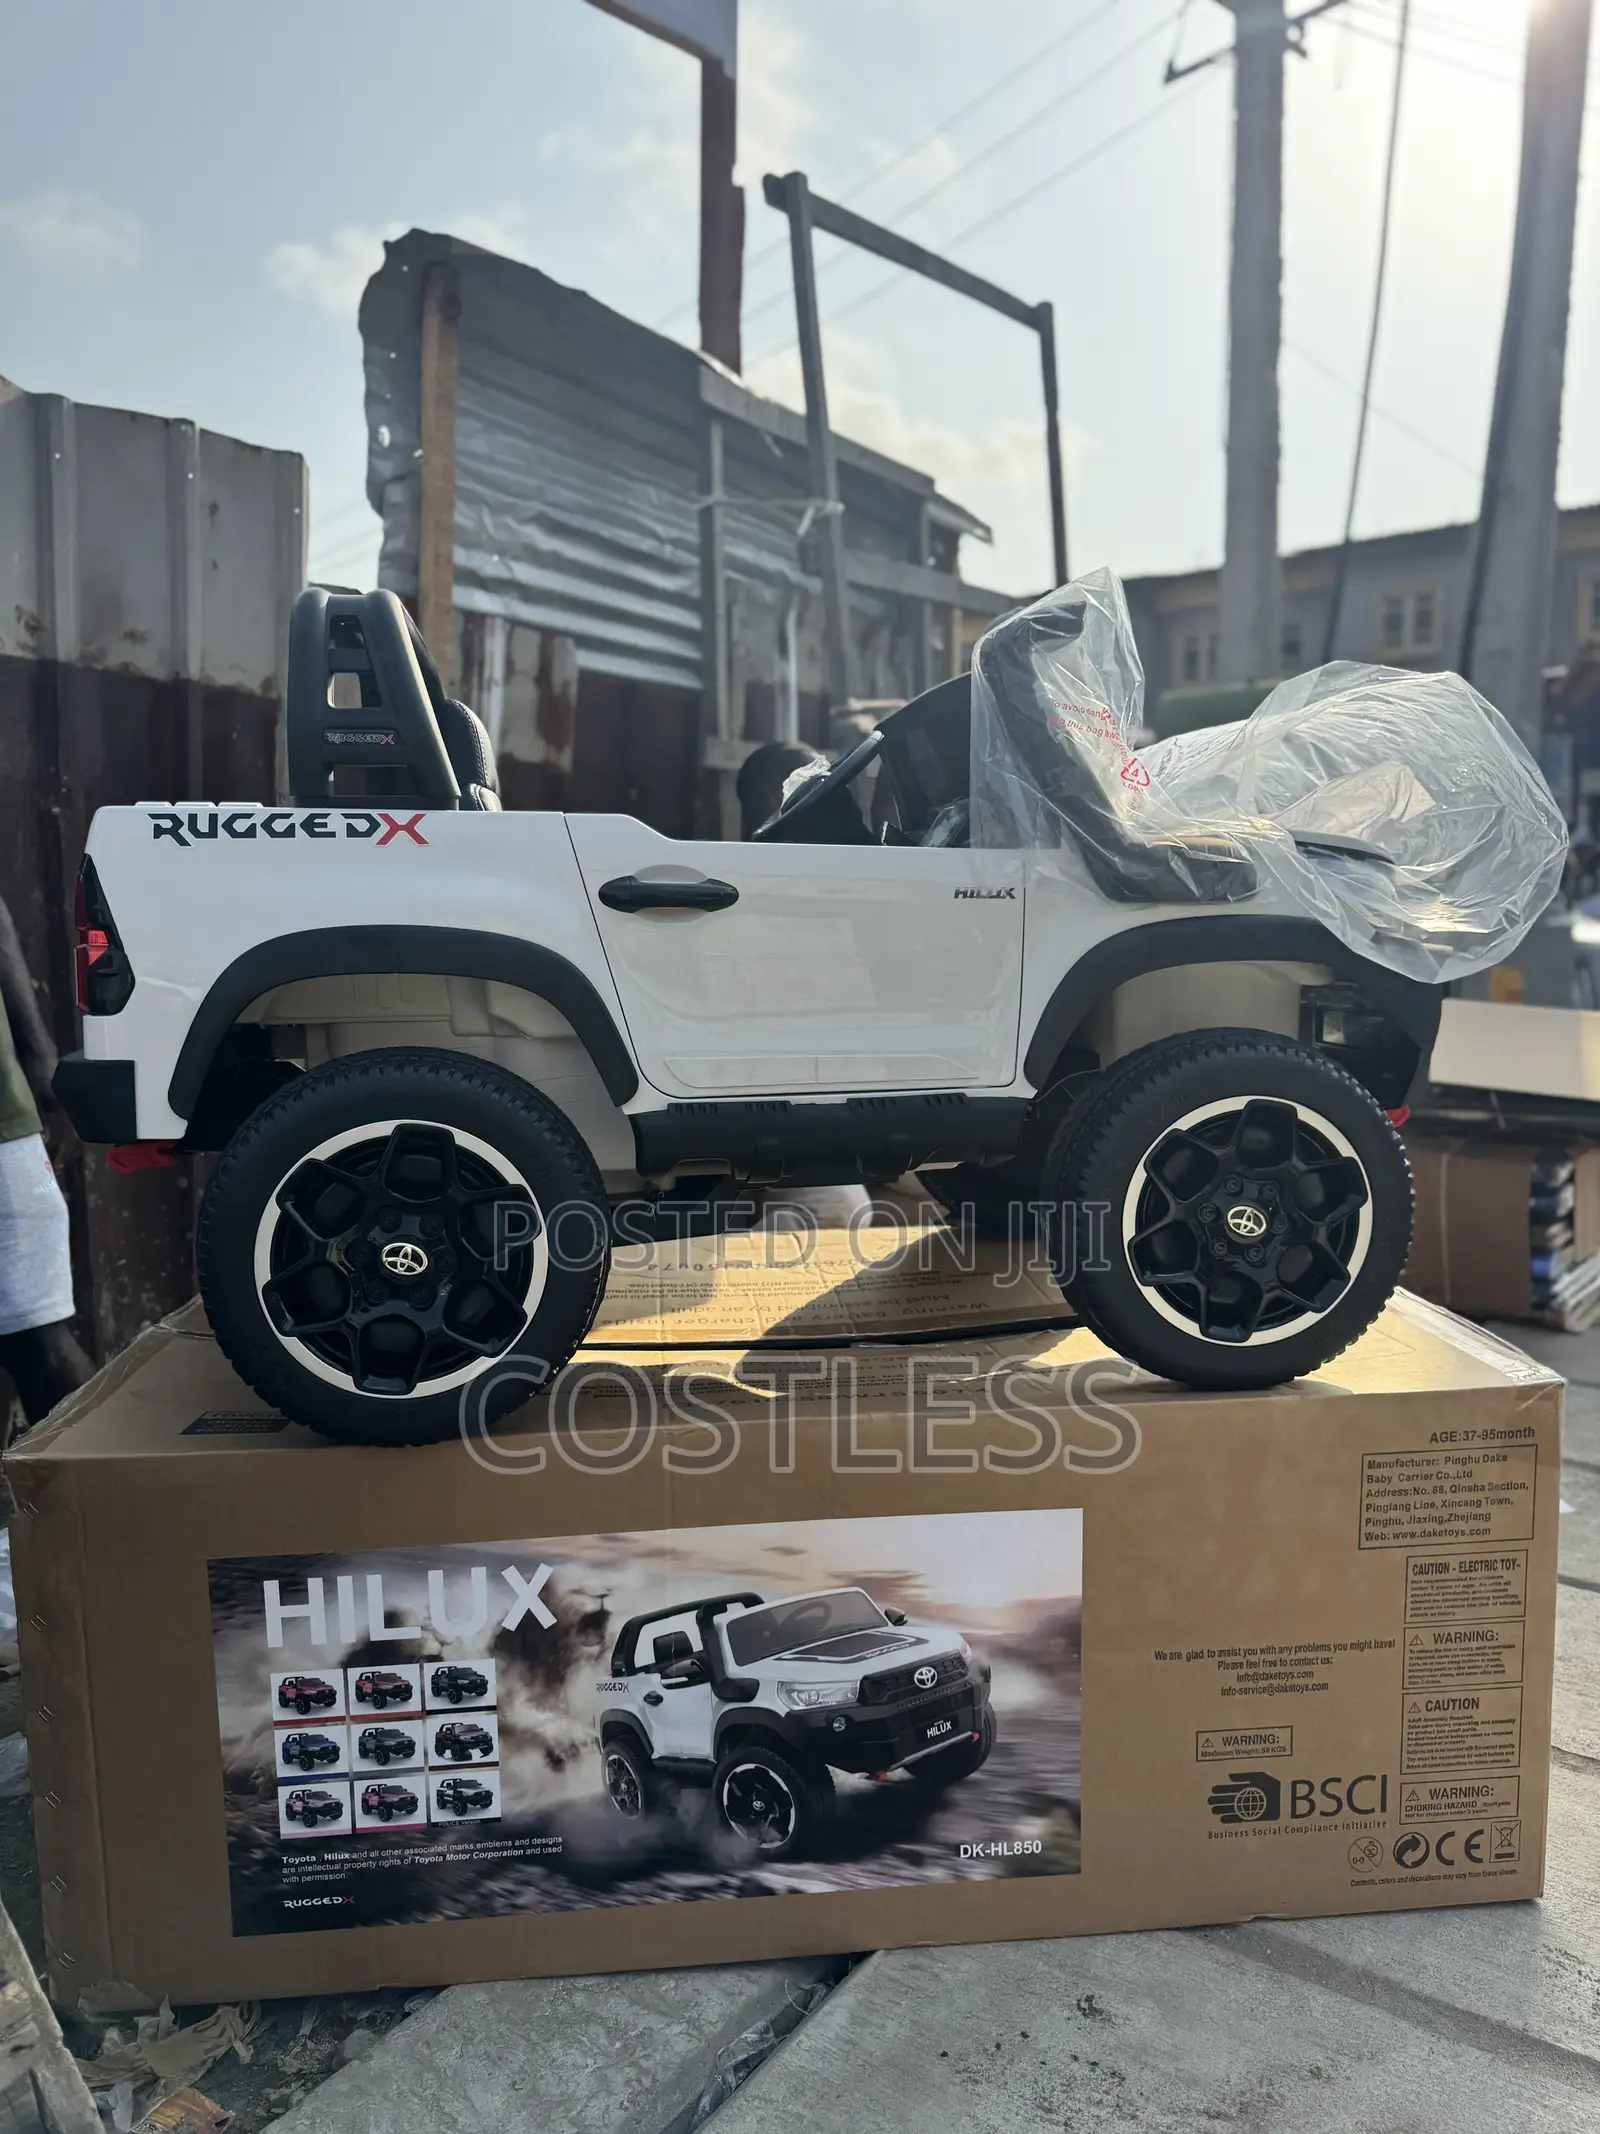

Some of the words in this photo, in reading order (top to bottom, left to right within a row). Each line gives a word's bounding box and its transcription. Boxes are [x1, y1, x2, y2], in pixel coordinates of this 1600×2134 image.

[326, 732, 395, 745] RUGGEDX
[1086, 726, 1103, 738] bag
[148, 812, 430, 847] RUGGEDX
[953, 886, 1016, 900] HILUX
[1429, 1426, 1535, 1444] AGE:37-95month
[1367, 1457, 1440, 1470] Manufacturer:
[1444, 1455, 1480, 1468] Pinghu
[1482, 1453, 1508, 1464] Dake
[1366, 1474, 1393, 1485] Baby
[1397, 1472, 1434, 1482] Carrier
[1487, 1481, 1529, 1492] Section,
[1440, 1498, 1482, 1510] Xincang
[1484, 1496, 1514, 1507] Town,
[1365, 1516, 1404, 1529] Pinghu,
[1364, 1531, 1390, 1542] Web:
[1392, 1527, 1491, 1541] www.daketoys.com
[1412, 1562, 1450, 1576] CAUTION
[1459, 1559, 1498, 1573] ELECTRIC
[263, 1562, 558, 1649] HILUX
[1433, 1630, 1499, 1645] WARNING:
[1154, 1650, 1167, 1661] We
[1169, 1652, 1183, 1660] are
[1186, 1649, 1204, 1662] glad
[1207, 1648, 1216, 1659] to
[1217, 1646, 1242, 1658] assist
[1243, 1647, 1258, 1659] you
[1259, 1644, 1277, 1656] with
[1278, 1645, 1293, 1657] any
[1294, 1641, 1332, 1655] problems
[1333, 1641, 1348, 1653] you
[1349, 1639, 1373, 1652] might
[1217, 1659, 1244, 1671] Please
[1246, 1658, 1261, 1669] feel
[1262, 1657, 1278, 1668] free
[1279, 1658, 1288, 1667] to
[1289, 1656, 1319, 1667] contact
[1320, 1655, 1333, 1665] us:
[1236, 1669, 1315, 1683] info@daketoys.com
[1221, 1681, 1329, 1697] info-service@daketoys.com
[1425, 1697, 1480, 1712] CAUTION
[926, 1720, 952, 1739] HILUX
[1222, 1734, 1280, 1747] WARNING:
[1290, 1774, 1388, 1819] BSCI
[1429, 1785, 1495, 1800] WARNING:
[1405, 1803, 1442, 1812] CHOKING
[1444, 1801, 1477, 1810] HAZARD
[1207, 1828, 1249, 1840] Business
[1252, 1826, 1281, 1837] Social
[1284, 1822, 1339, 1836] Compliance
[1342, 1819, 1387, 1831] Initiative
[281, 1855, 317, 1864] Toyota
[324, 1852, 350, 1861] Hilux
[351, 1850, 368, 1858] and
[370, 1849, 379, 1857] all
[381, 1848, 402, 1857] other
[404, 1844, 447, 1855] associated
[514, 1837, 530, 1846] and
[531, 1836, 563, 1845] designs
[959, 1839, 1043, 1859] DK-HL850
[1434, 1828, 1485, 1866] CE
[297, 1862, 341, 1873] intellectual
[343, 1860, 377, 1871] property
[379, 1858, 402, 1868] rights
[403, 1857, 412, 1865] of
[414, 1854, 443, 1865] Toyota
[445, 1852, 471, 1861] Motor
[472, 1848, 524, 1860] Corporation
[525, 1847, 541, 1855] and
[542, 1844, 563, 1854] used
[282, 1875, 300, 1883] with
[301, 1872, 348, 1884] permission.
[283, 1895, 355, 1909] RUGGEDX
